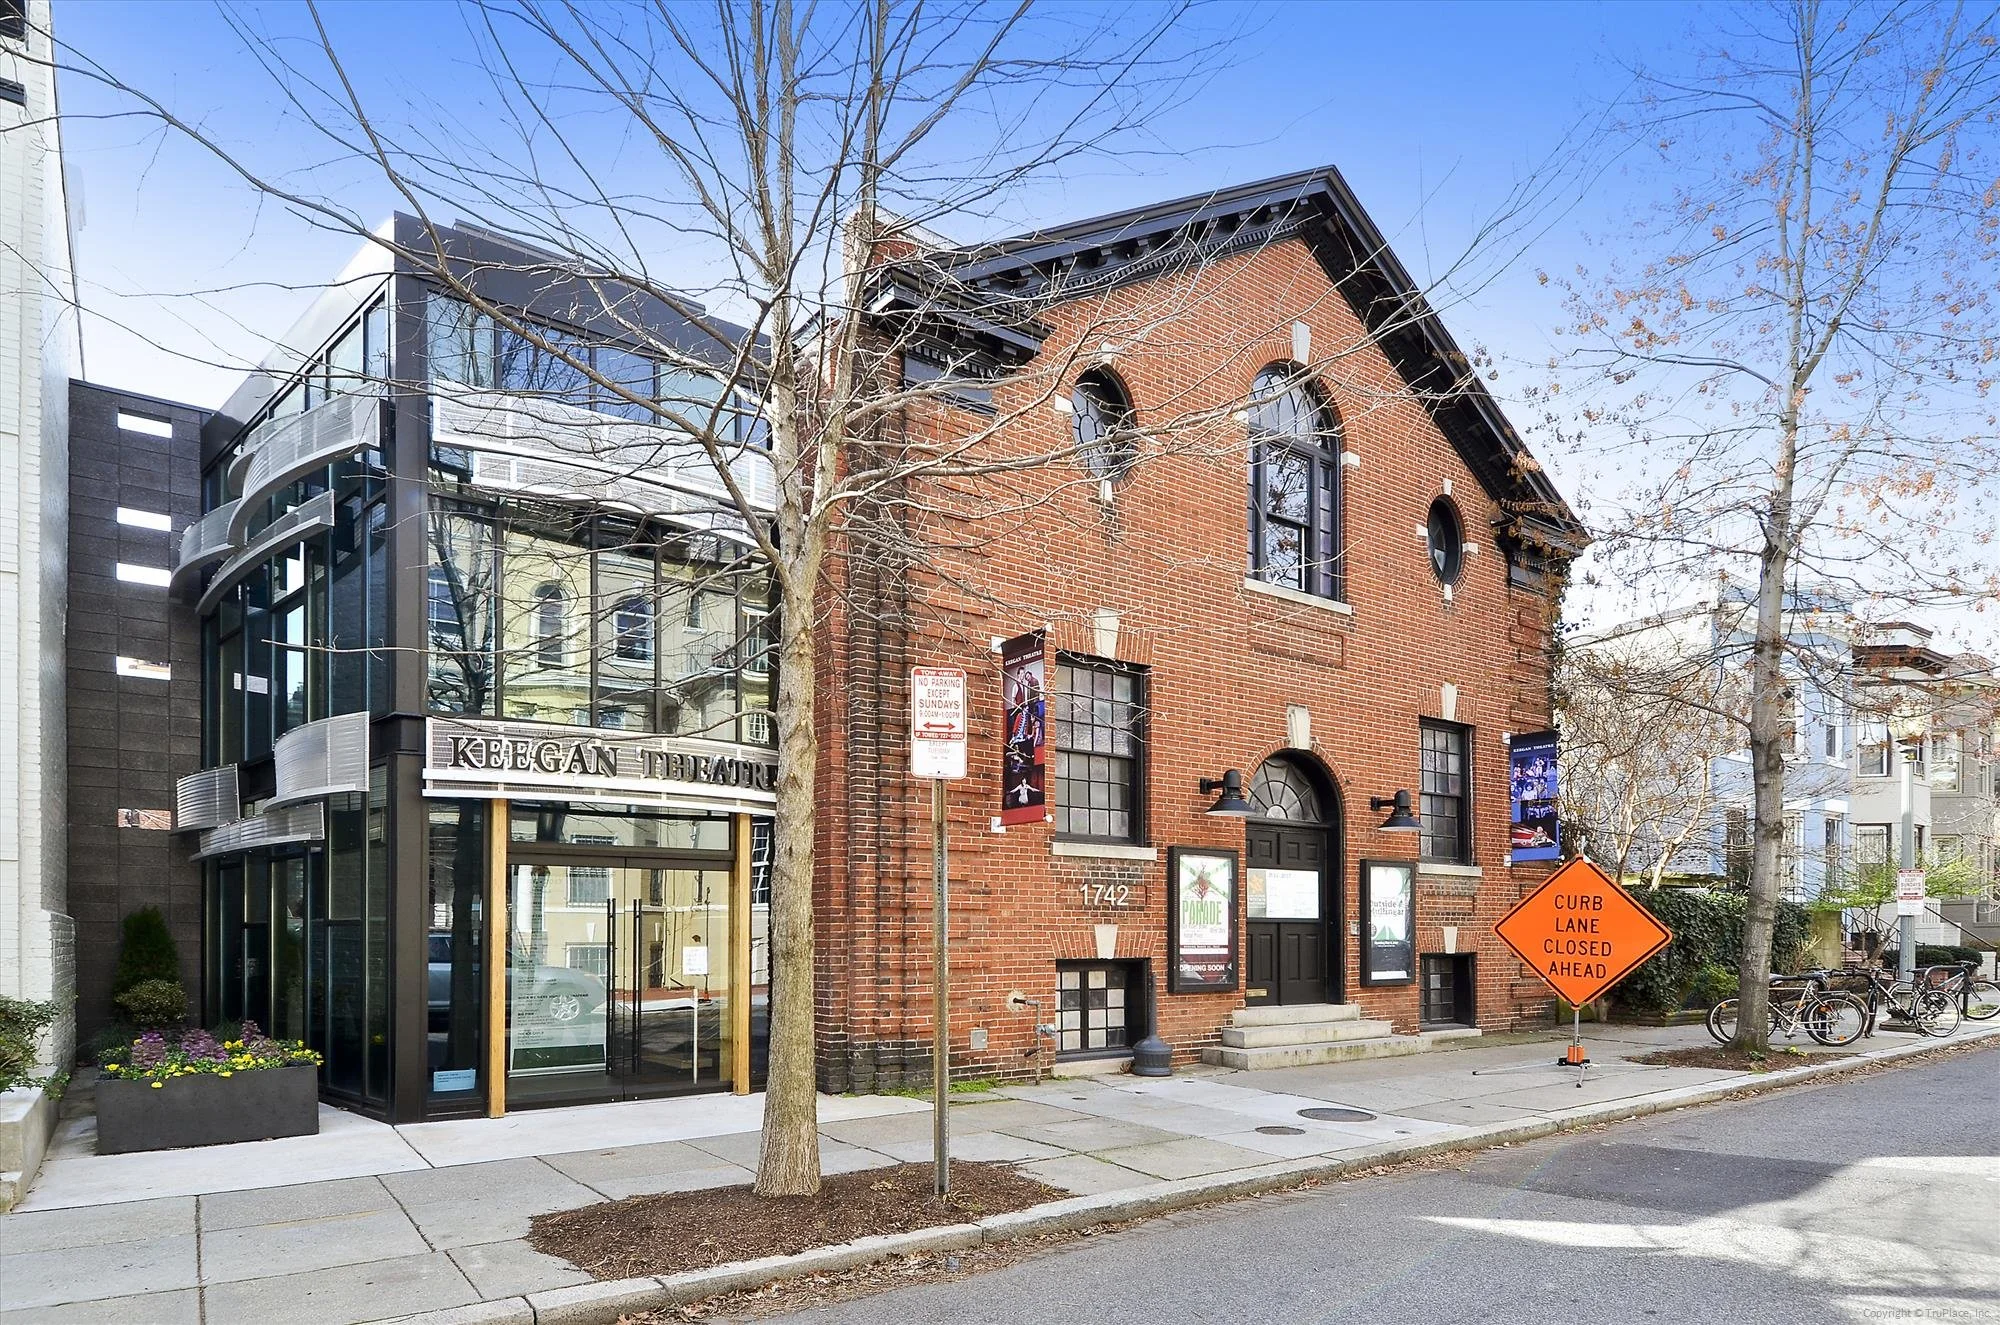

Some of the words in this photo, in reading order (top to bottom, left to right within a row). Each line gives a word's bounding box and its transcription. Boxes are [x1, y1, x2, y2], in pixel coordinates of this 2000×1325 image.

[918, 678, 928, 686] NO
[932, 679, 961, 688] PARKING
[927, 689, 950, 698] EXCEPT
[919, 699, 960, 709] SUNDAYS
[448, 735, 620, 777] KEEGAN
[1079, 883, 1129, 906] 1742
[1554, 895, 1603, 911] CURB
[1182, 900, 1222, 926] PARADE
[1555, 917, 1600, 934] LANE
[1544, 938, 1612, 957] CLOSED
[1180, 964, 1207, 972] OPENING
[1548, 962, 1607, 979] AHEAD
